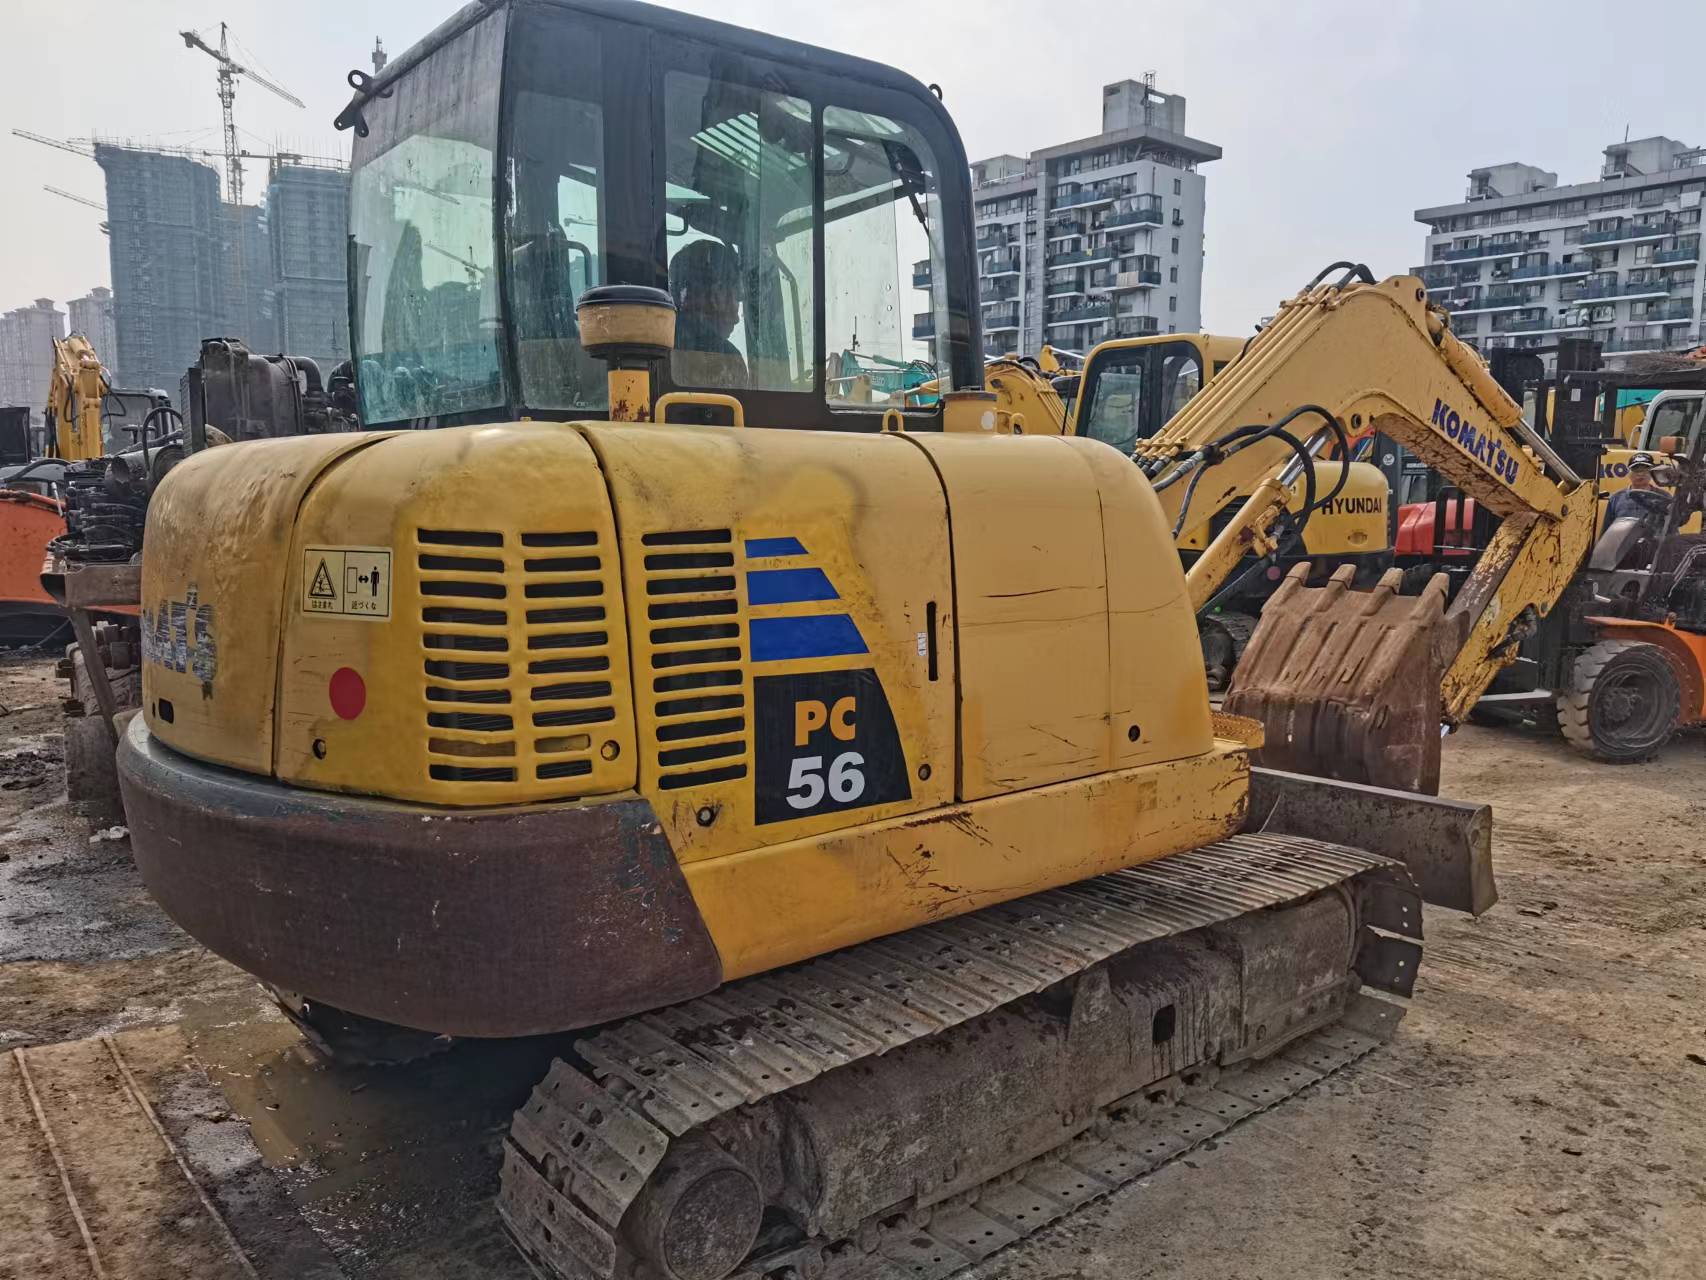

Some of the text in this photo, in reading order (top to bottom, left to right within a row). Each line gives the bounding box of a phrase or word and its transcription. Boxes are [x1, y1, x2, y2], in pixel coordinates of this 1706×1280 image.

[1431, 397, 1520, 485] KOMATSU
[1322, 497, 1382, 515] HYUNDAI
[794, 696, 856, 746] PC
[785, 751, 866, 810] 56
